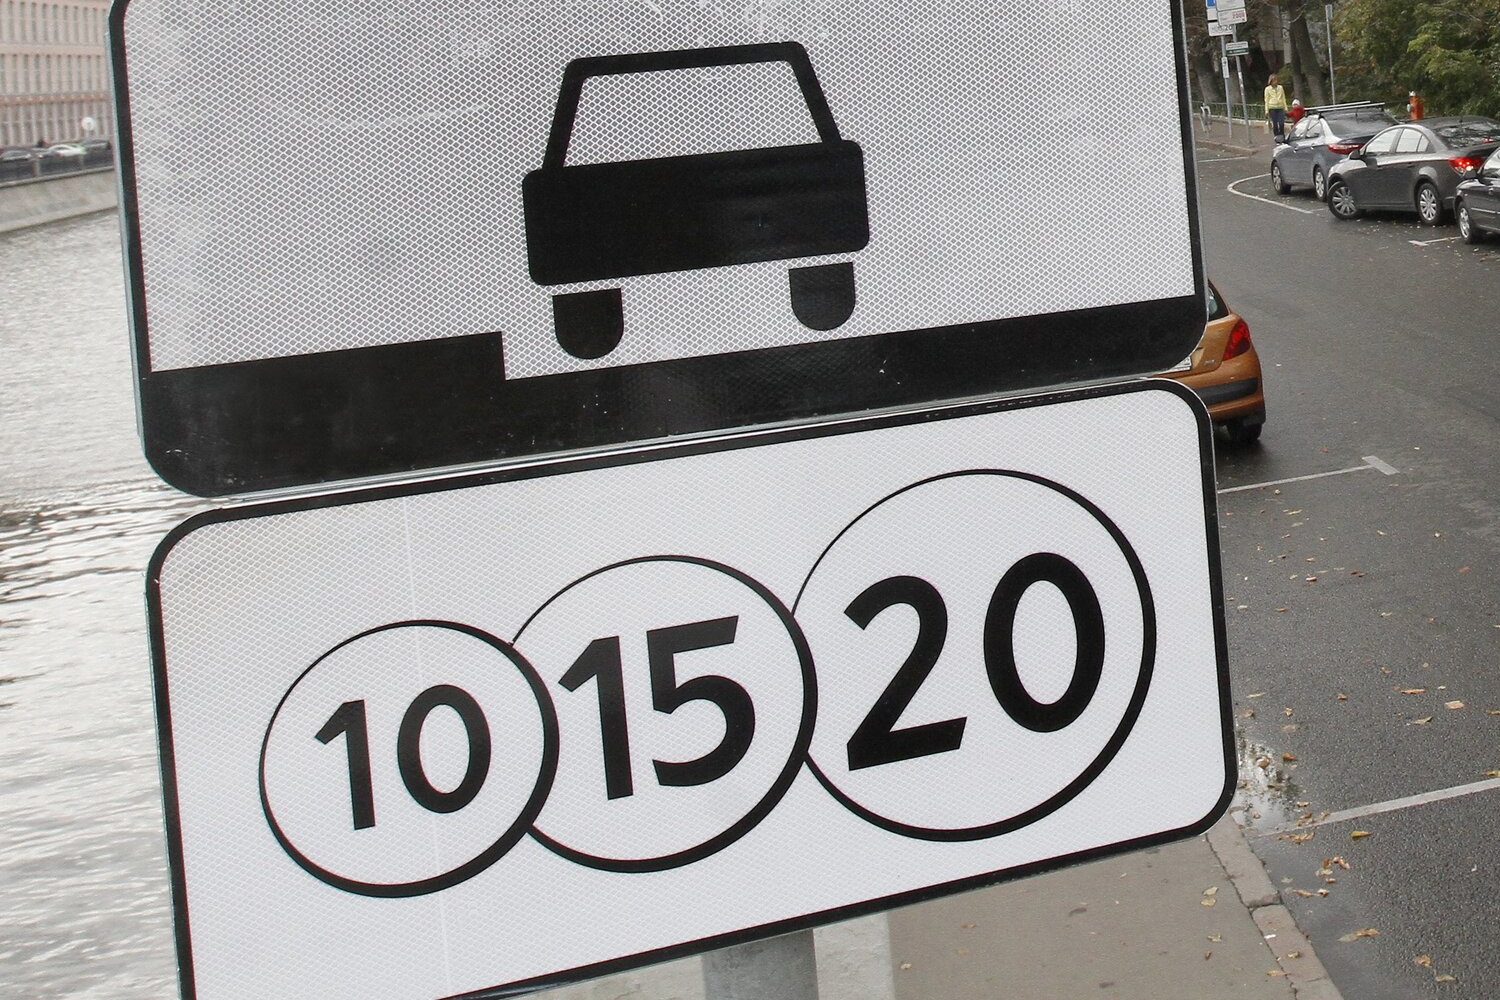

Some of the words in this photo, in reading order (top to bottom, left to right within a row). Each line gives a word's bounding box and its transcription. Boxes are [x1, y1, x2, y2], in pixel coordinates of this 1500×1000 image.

[314, 683, 492, 830] 10
[557, 614, 757, 800] 15
[842, 551, 1106, 771] 20
